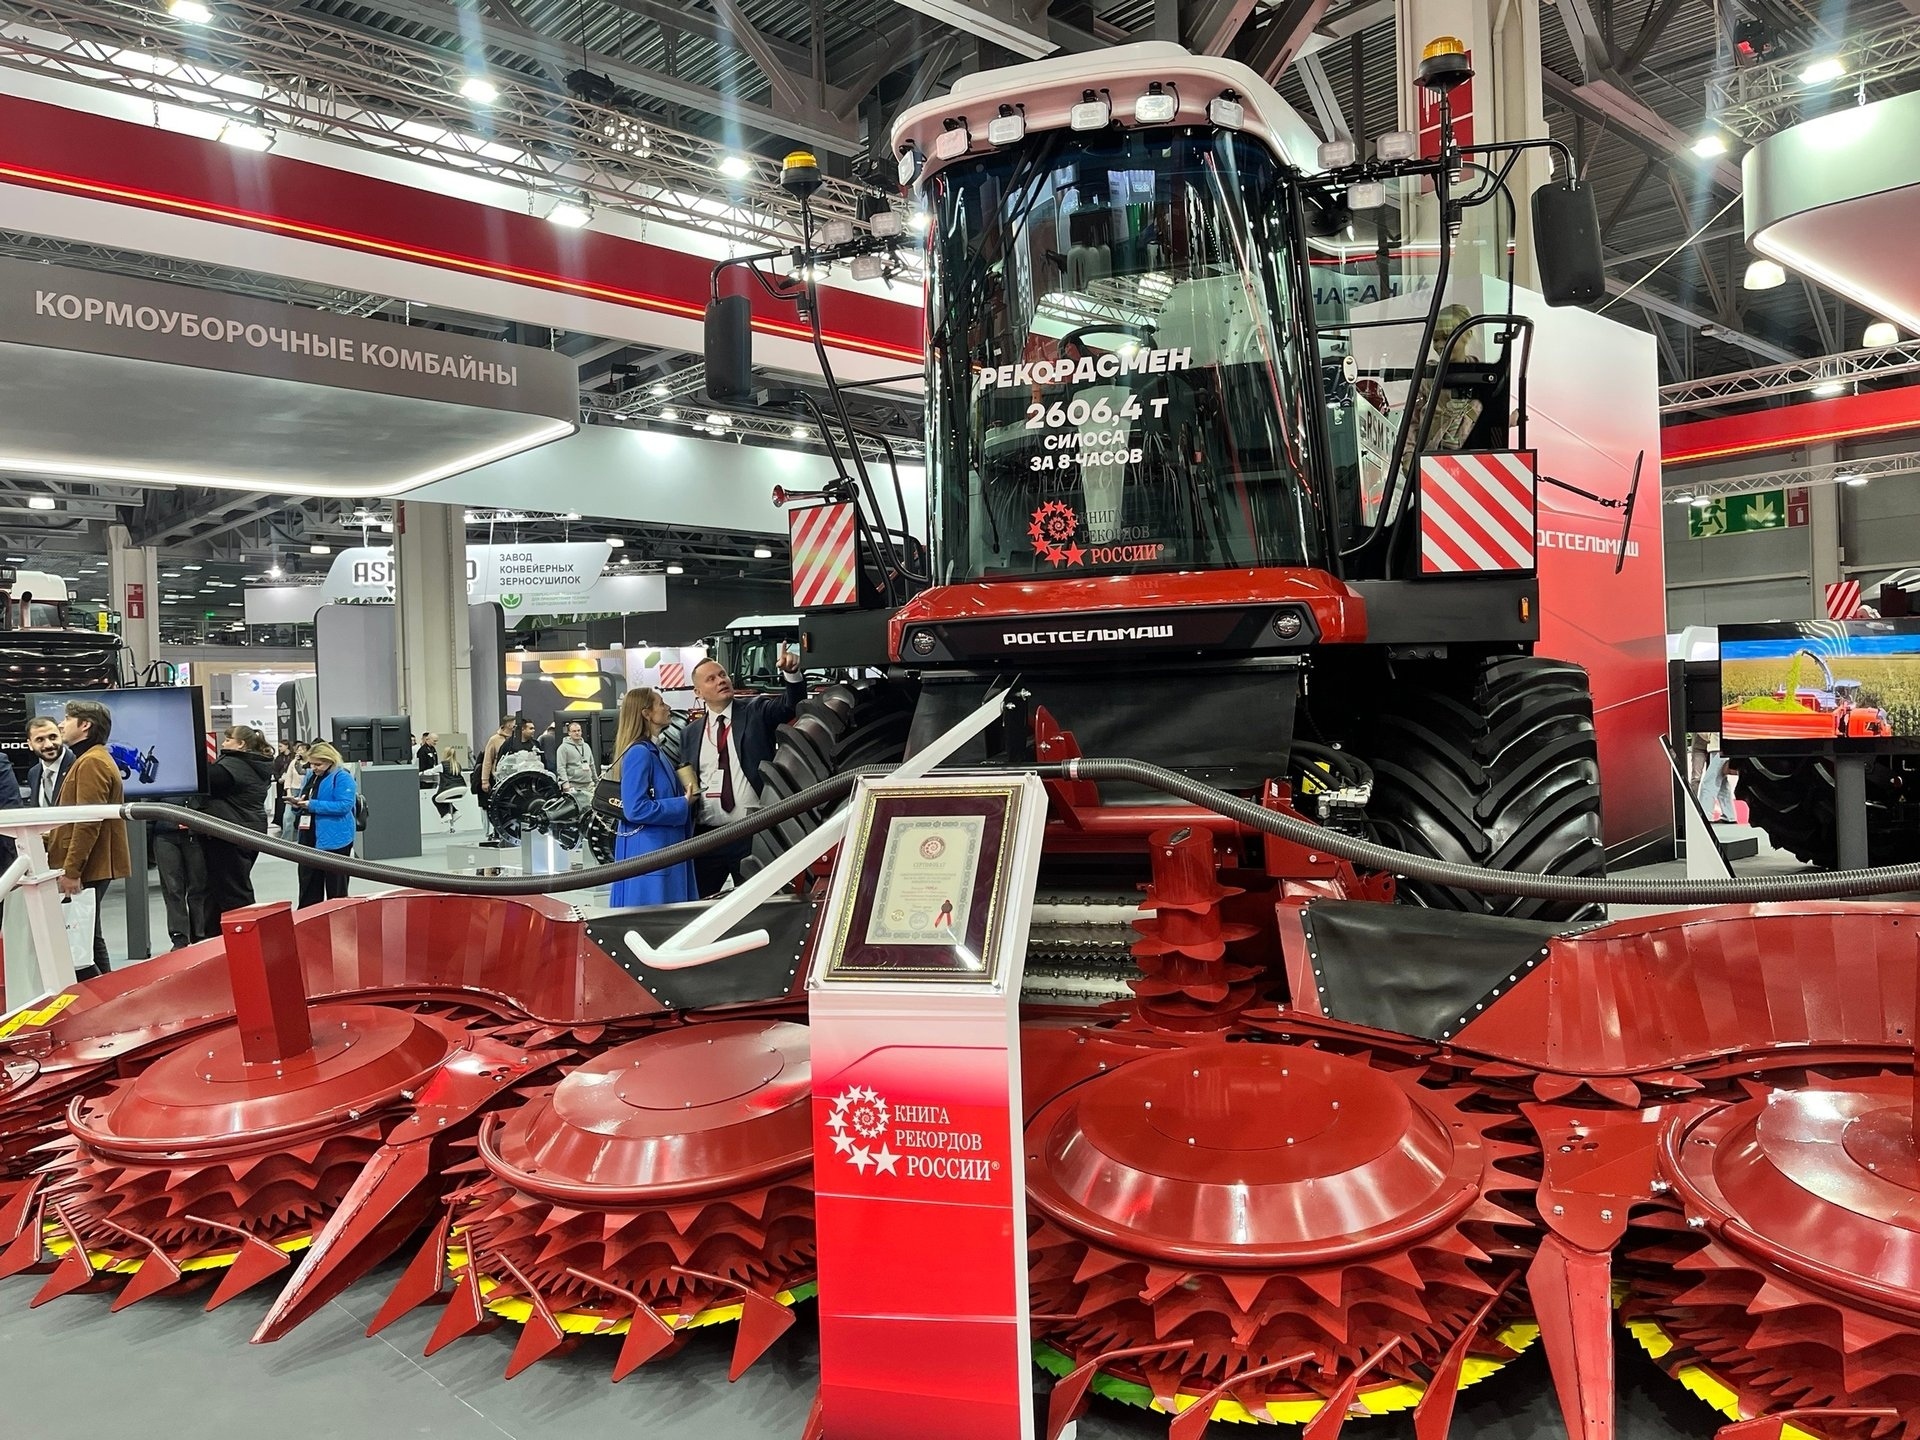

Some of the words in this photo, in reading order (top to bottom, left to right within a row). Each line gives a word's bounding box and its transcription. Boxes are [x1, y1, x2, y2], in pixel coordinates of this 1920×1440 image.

[35, 290, 354, 362] КОРМОУБОРОЧНЫЕ
[361, 342, 518, 387] КОМБАЙНЫ
[980, 347, 1192, 390] РЕКОРДСМЕН
[1025, 394, 1143, 429] 2606,4
[1044, 430, 1125, 450] СИЛОСА
[1030, 455, 1054, 471] ЗА
[1058, 454, 1070, 470] 8
[1075, 448, 1143, 467] ЧАСОВ
[1080, 508, 1125, 525] КНИГА
[1081, 525, 1150, 543] РЕКОРДОВ
[499, 553, 533, 563] ЗАВОД
[499, 563, 574, 575] КОНВЕЙЕРНЫХ
[499, 575, 581, 586] ЗЕРНОСУШИЛОК
[1002, 625, 1174, 646] РОСТСЕЛЬМАШ
[894, 1104, 950, 1125] КНИГА
[895, 1129, 983, 1153] РЕКОРДОВ
